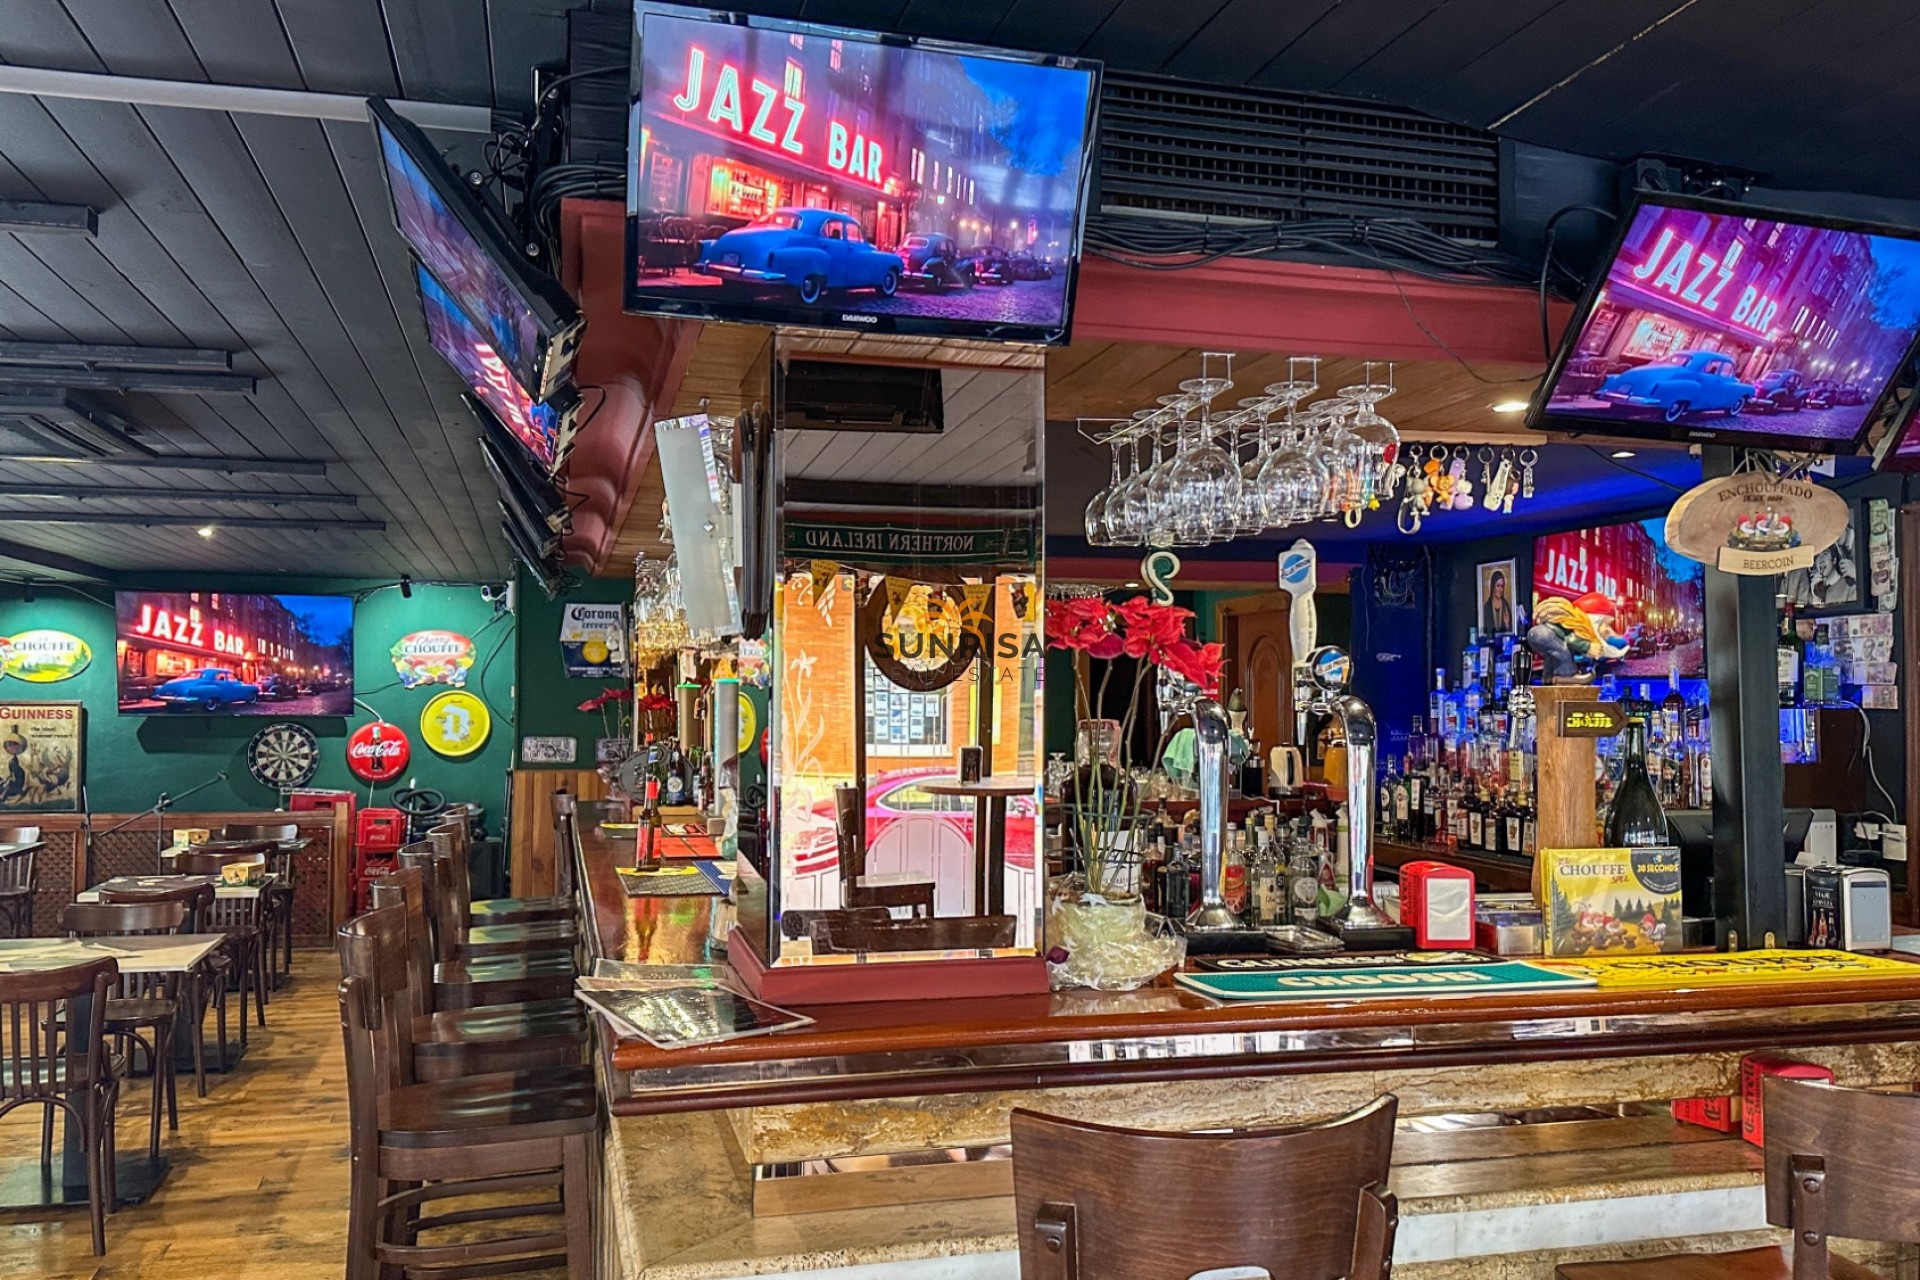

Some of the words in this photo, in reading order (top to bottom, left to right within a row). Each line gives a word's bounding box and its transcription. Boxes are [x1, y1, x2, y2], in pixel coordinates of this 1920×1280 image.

[673, 48, 805, 154] JAZZ
[828, 121, 882, 183] BAR
[1633, 228, 1733, 311] JAZZ
[1731, 285, 1777, 333] BAR
[842, 314, 877, 323] DAEWOO
[1718, 483, 1813, 502] ENCHOUFFADO
[1743, 556, 1794, 569] BEERCOIN
[1545, 549, 1588, 593] JAZZ
[1595, 571, 1617, 600] BAR
[571, 606, 619, 620] Corona
[136, 604, 204, 647] JAZZ
[214, 629, 244, 656] BAR
[13, 642, 75, 651] CHOUFFE
[405, 644, 461, 653] CHOUFFE
[0, 708, 73, 720] GUINNESS
[351, 741, 403, 758] Coca-Cola
[1560, 865, 1625, 875] CHOUFFE
[1277, 972, 1493, 987] CHOOSE!
